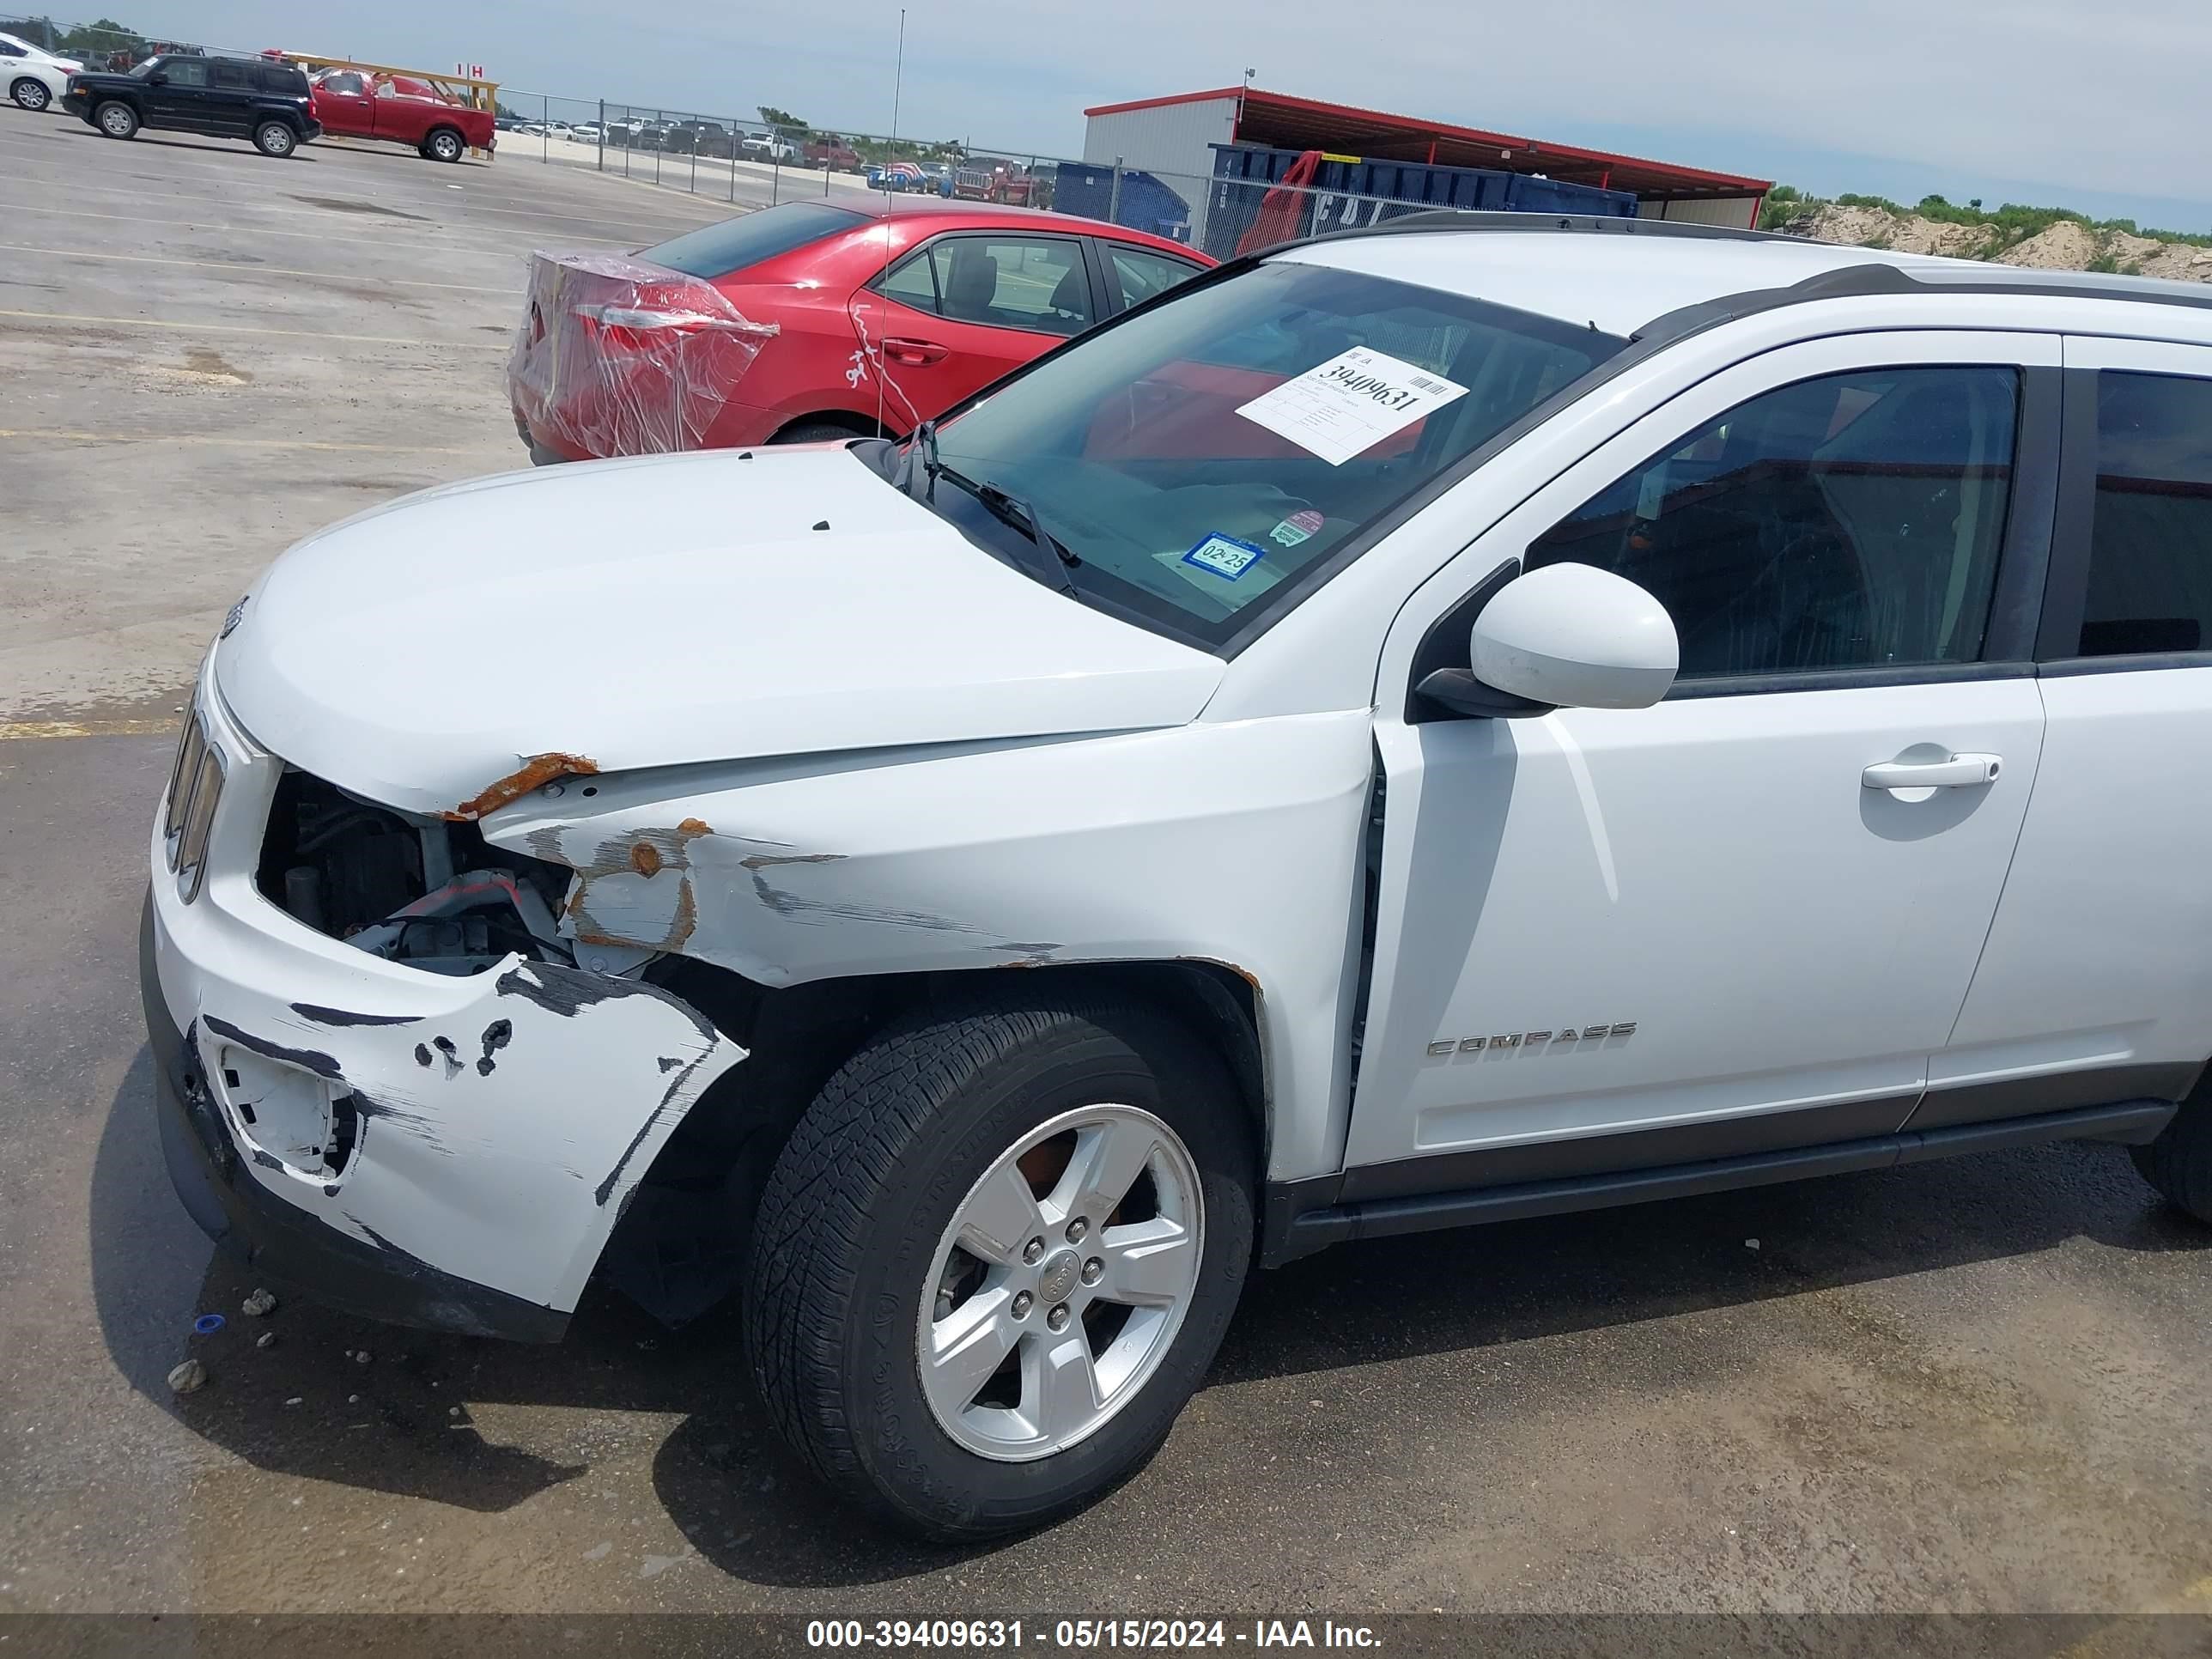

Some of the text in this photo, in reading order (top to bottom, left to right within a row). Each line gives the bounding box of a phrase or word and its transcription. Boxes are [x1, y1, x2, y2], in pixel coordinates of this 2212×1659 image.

[1319, 365, 1421, 411] 39409631
[1203, 545, 1248, 568] 02 25
[1427, 1022, 1638, 1057] COMPASS
